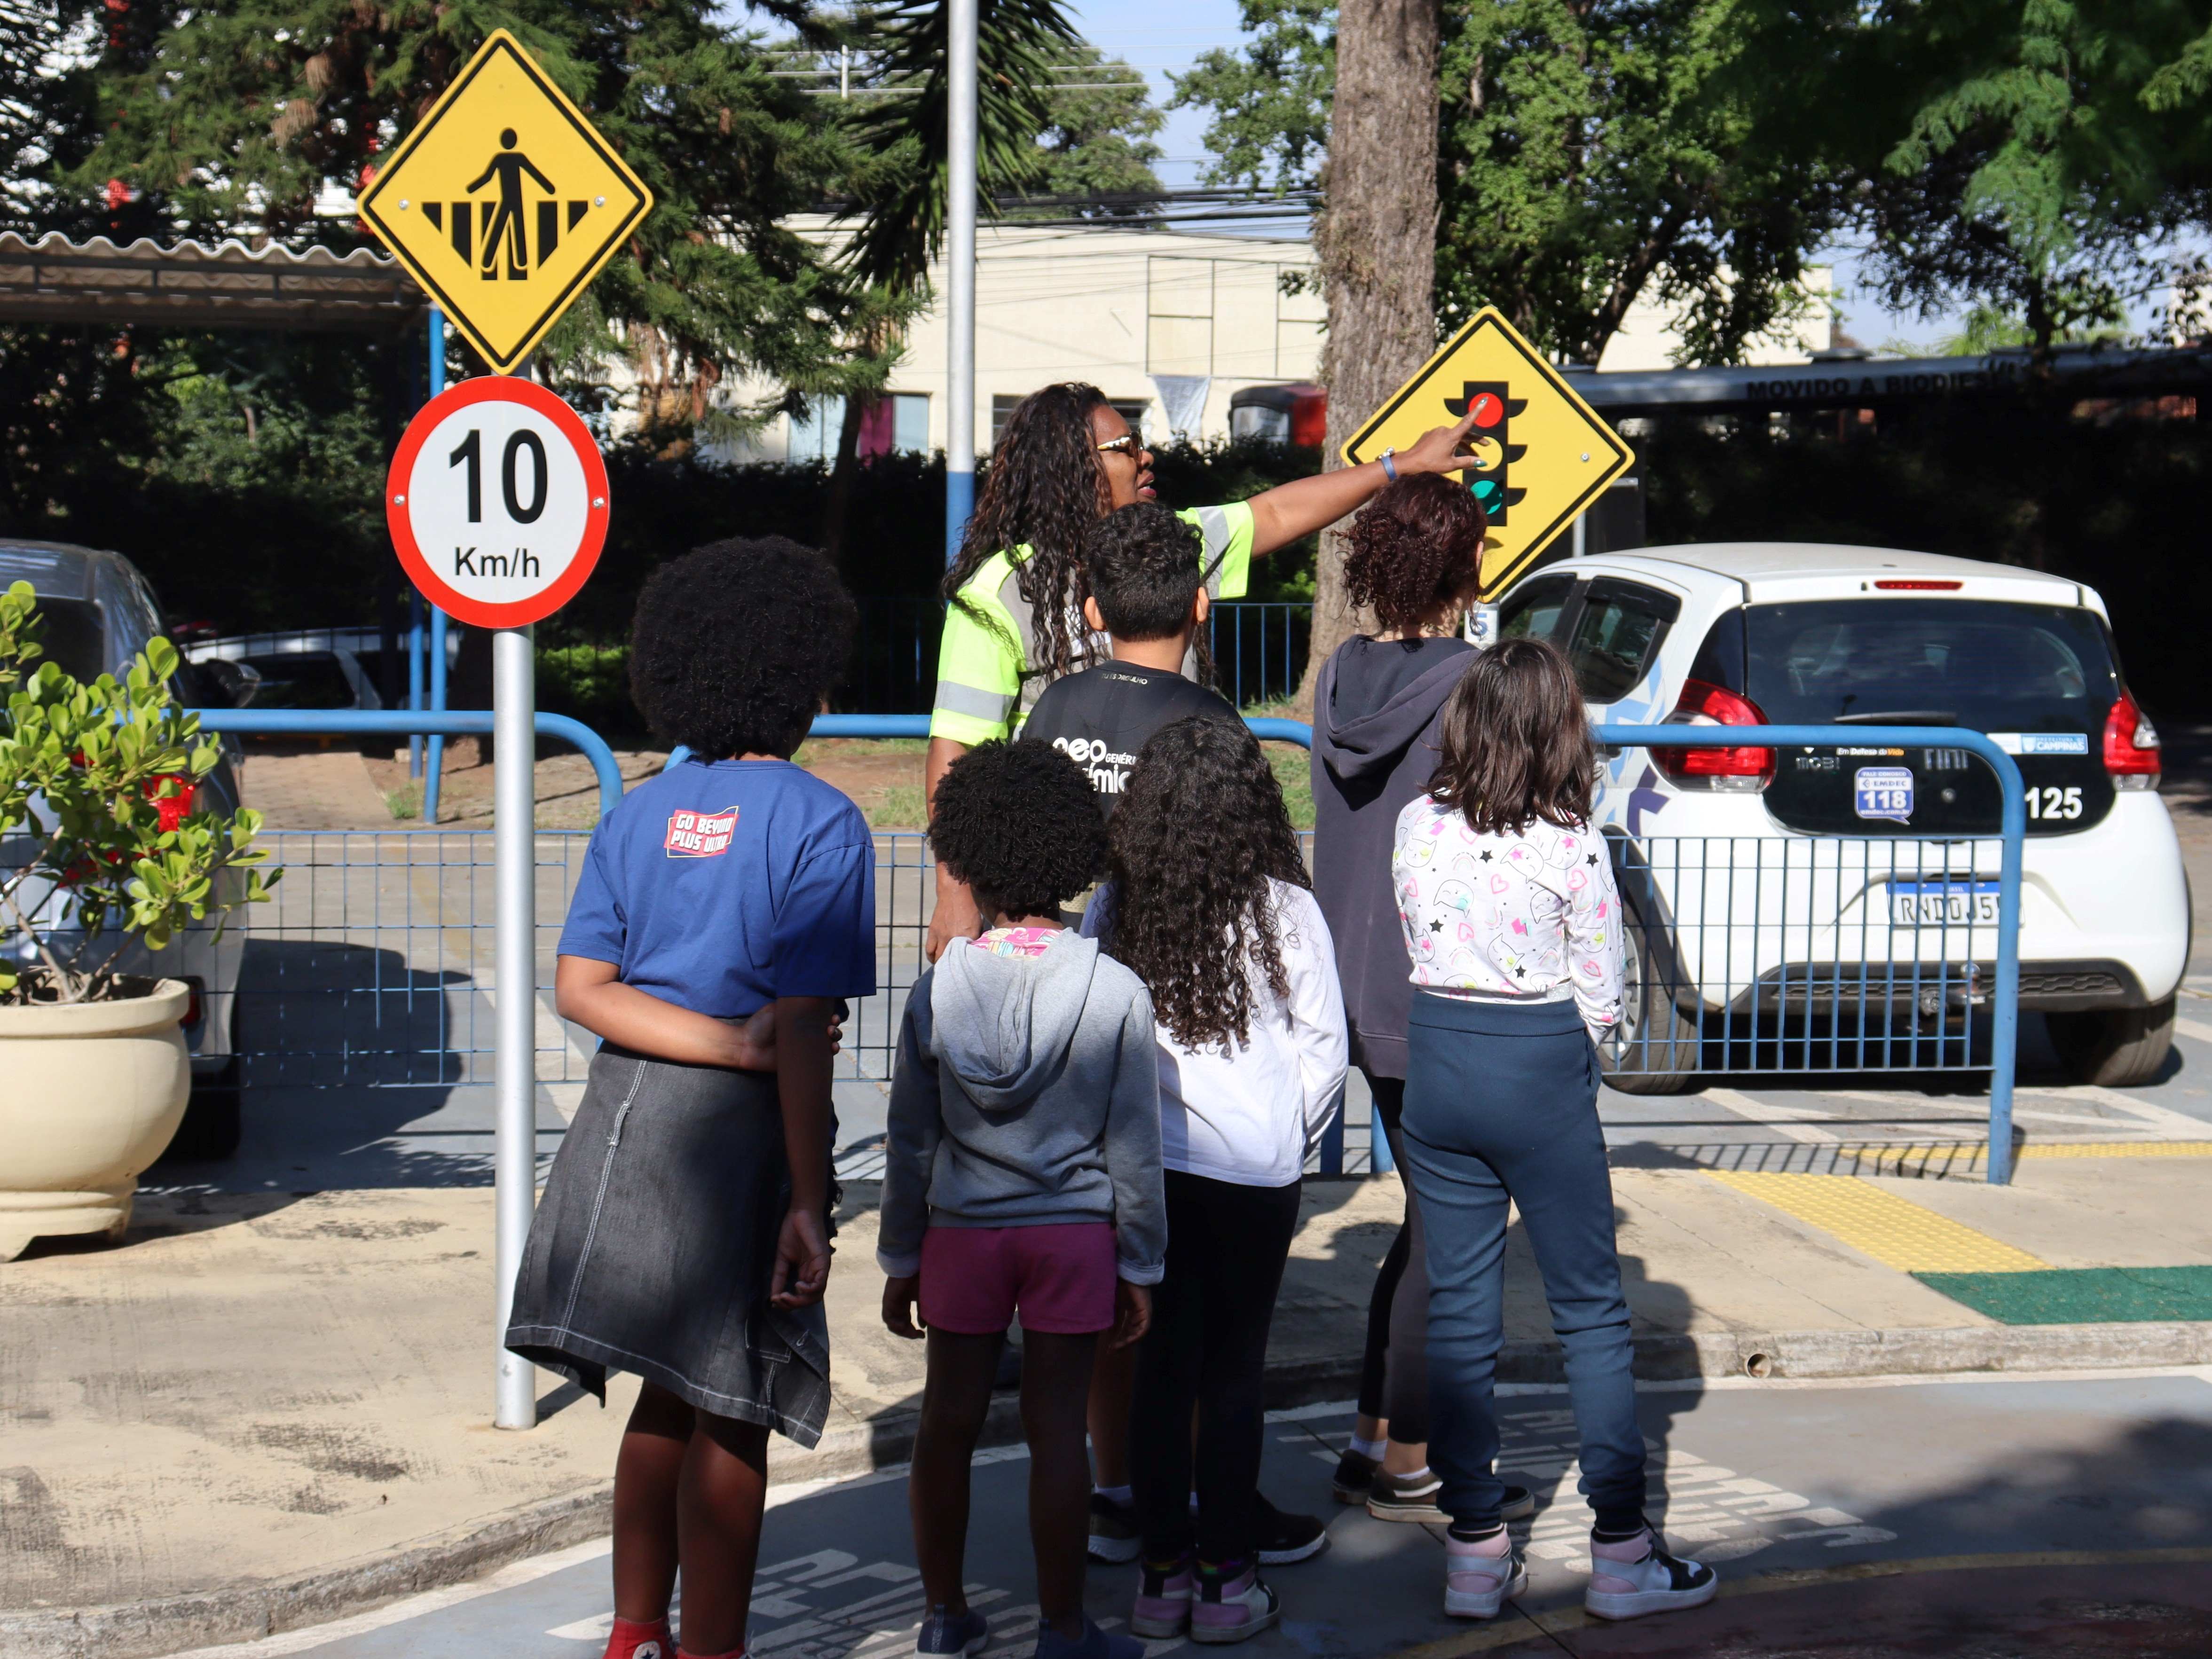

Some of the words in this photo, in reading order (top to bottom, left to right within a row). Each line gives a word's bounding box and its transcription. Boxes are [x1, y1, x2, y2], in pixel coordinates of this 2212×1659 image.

[1747, 377, 1850, 400] MOVIDO
[1859, 377, 1878, 394] A
[449, 428, 548, 524] 10
[454, 546, 539, 577] Km/h
[1052, 737, 1107, 763] neo
[1850, 747, 1877, 756] Defesa
[1887, 747, 1904, 756] Vida
[2037, 741, 2085, 751] CAMPINAS
[1863, 790, 1907, 809] 118
[2024, 786, 2083, 819] 125
[676, 814, 695, 831] GO
[696, 817, 734, 834] BEYOND
[670, 830, 702, 851] PLUS
[703, 834, 729, 853] ULTRA
